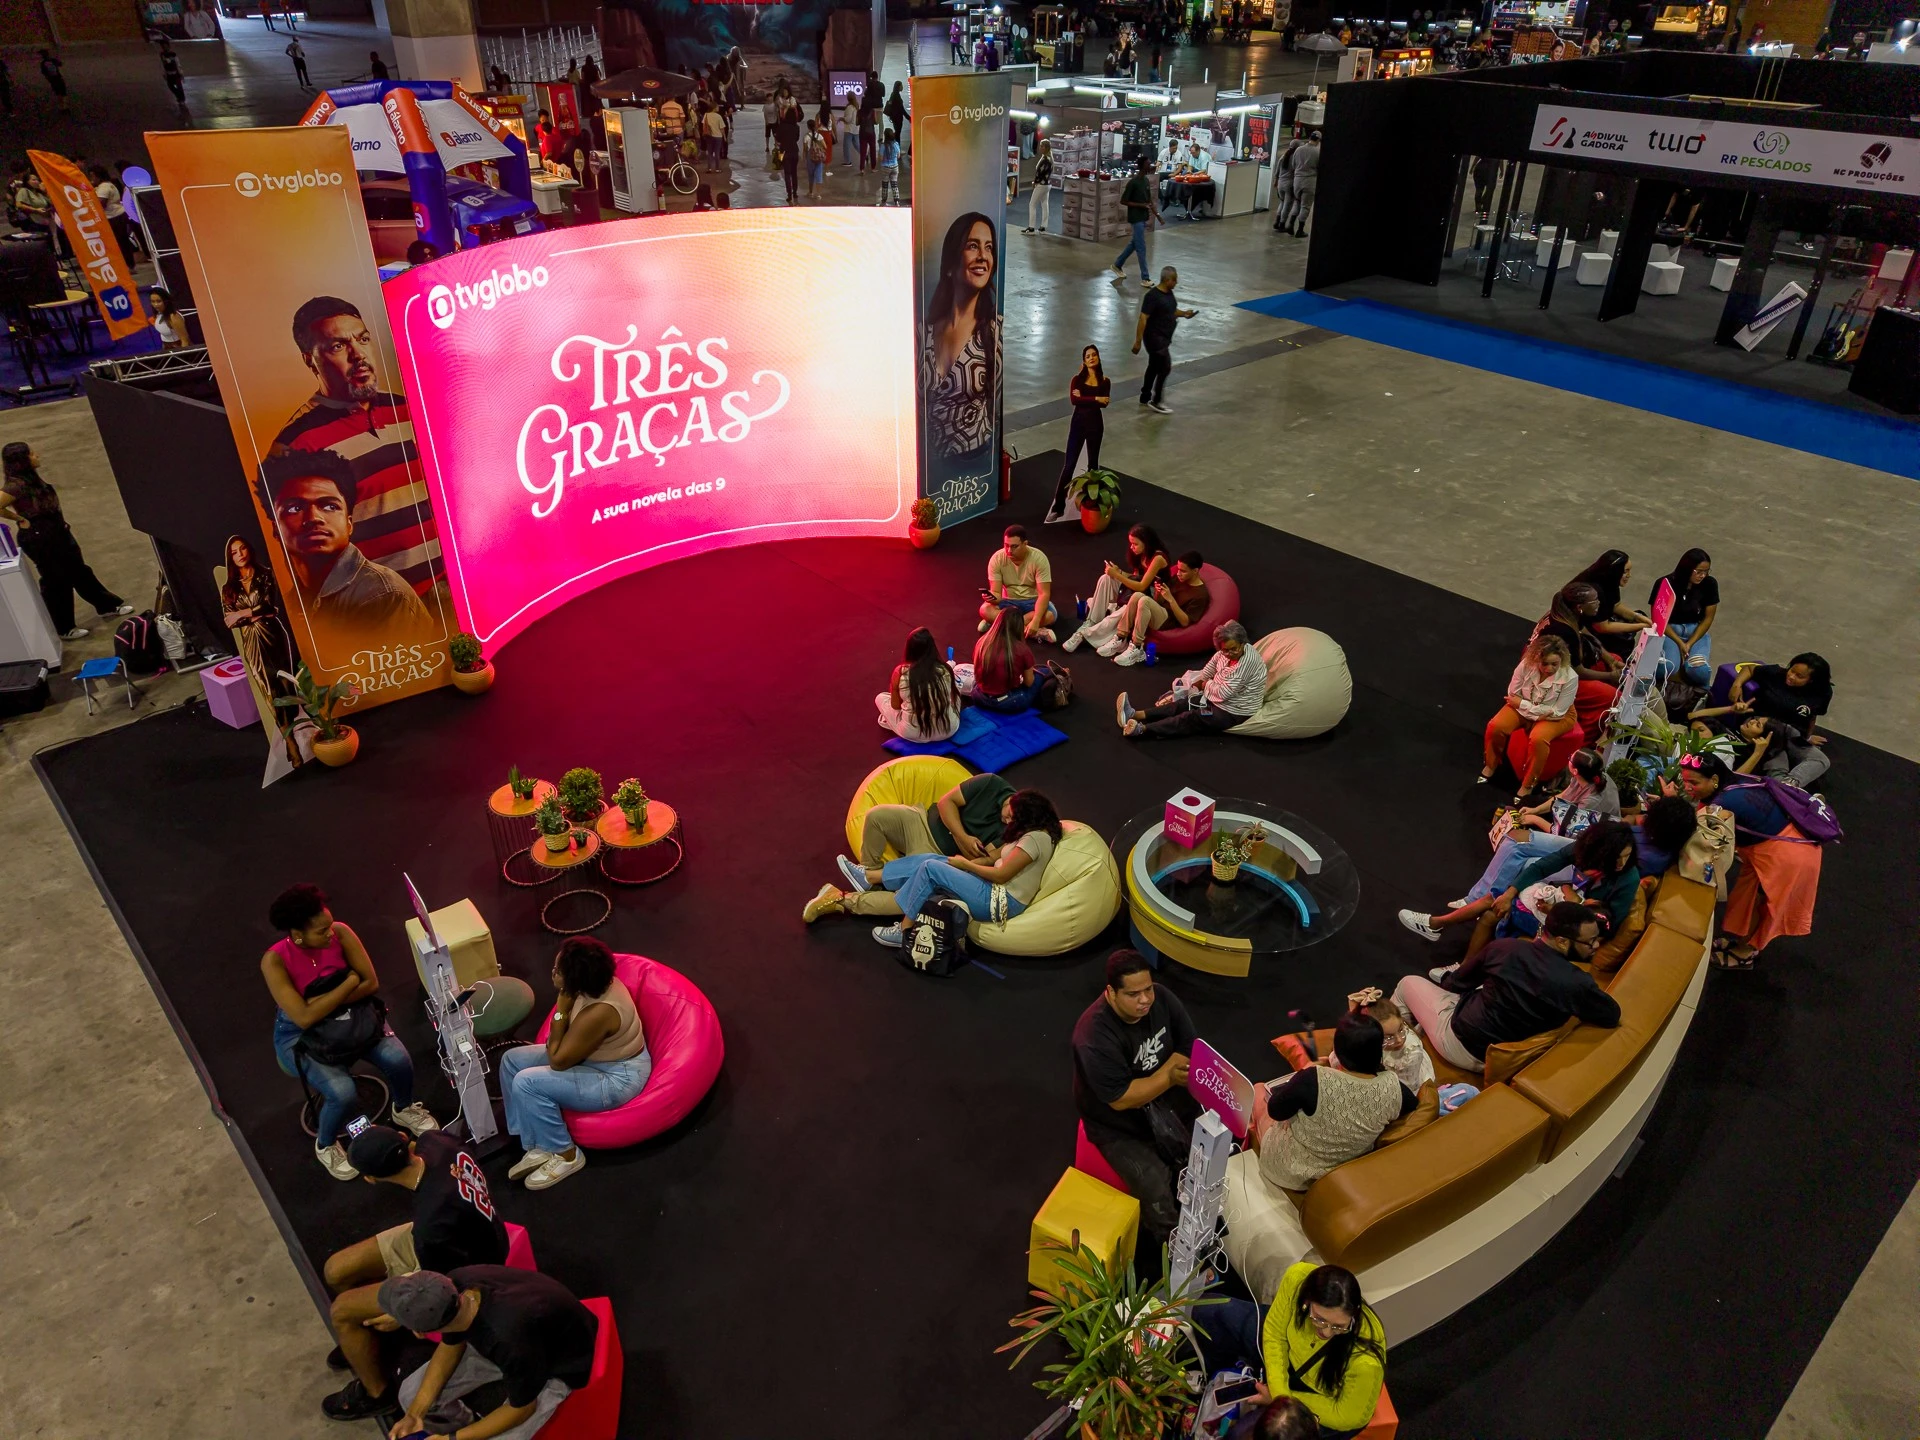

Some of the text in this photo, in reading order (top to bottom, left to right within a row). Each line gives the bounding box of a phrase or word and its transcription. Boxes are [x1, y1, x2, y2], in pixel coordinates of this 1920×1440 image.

[303, 102, 330, 127] lamo
[459, 91, 490, 121] álamo
[964, 103, 1004, 121] tvglobo
[390, 111, 405, 145] álamo
[452, 131, 483, 145] álamo
[351, 137, 381, 151] lamo
[1581, 141, 1624, 151] GADORA
[1720, 154, 1812, 173] RR PESCADOS
[1848, 170, 1905, 182] PRODUÇÕES
[263, 168, 342, 193] tvglobo
[64, 185, 118, 284] álamo
[455, 264, 549, 311] tvglobo
[551, 324, 729, 411] TRÊS
[516, 369, 791, 518] GRAÇAS
[592, 477, 726, 524] A sua novela das 9
[942, 475, 979, 499] TRÊS
[351, 643, 422, 674] TRÊS
[915, 913, 945, 930] ANTED
[1133, 1026, 1166, 1064] NIKE
[1142, 1054, 1159, 1071] SB
[1195, 1068, 1243, 1112] GRAÇAS
[1207, 1067, 1235, 1100] TRÊS
